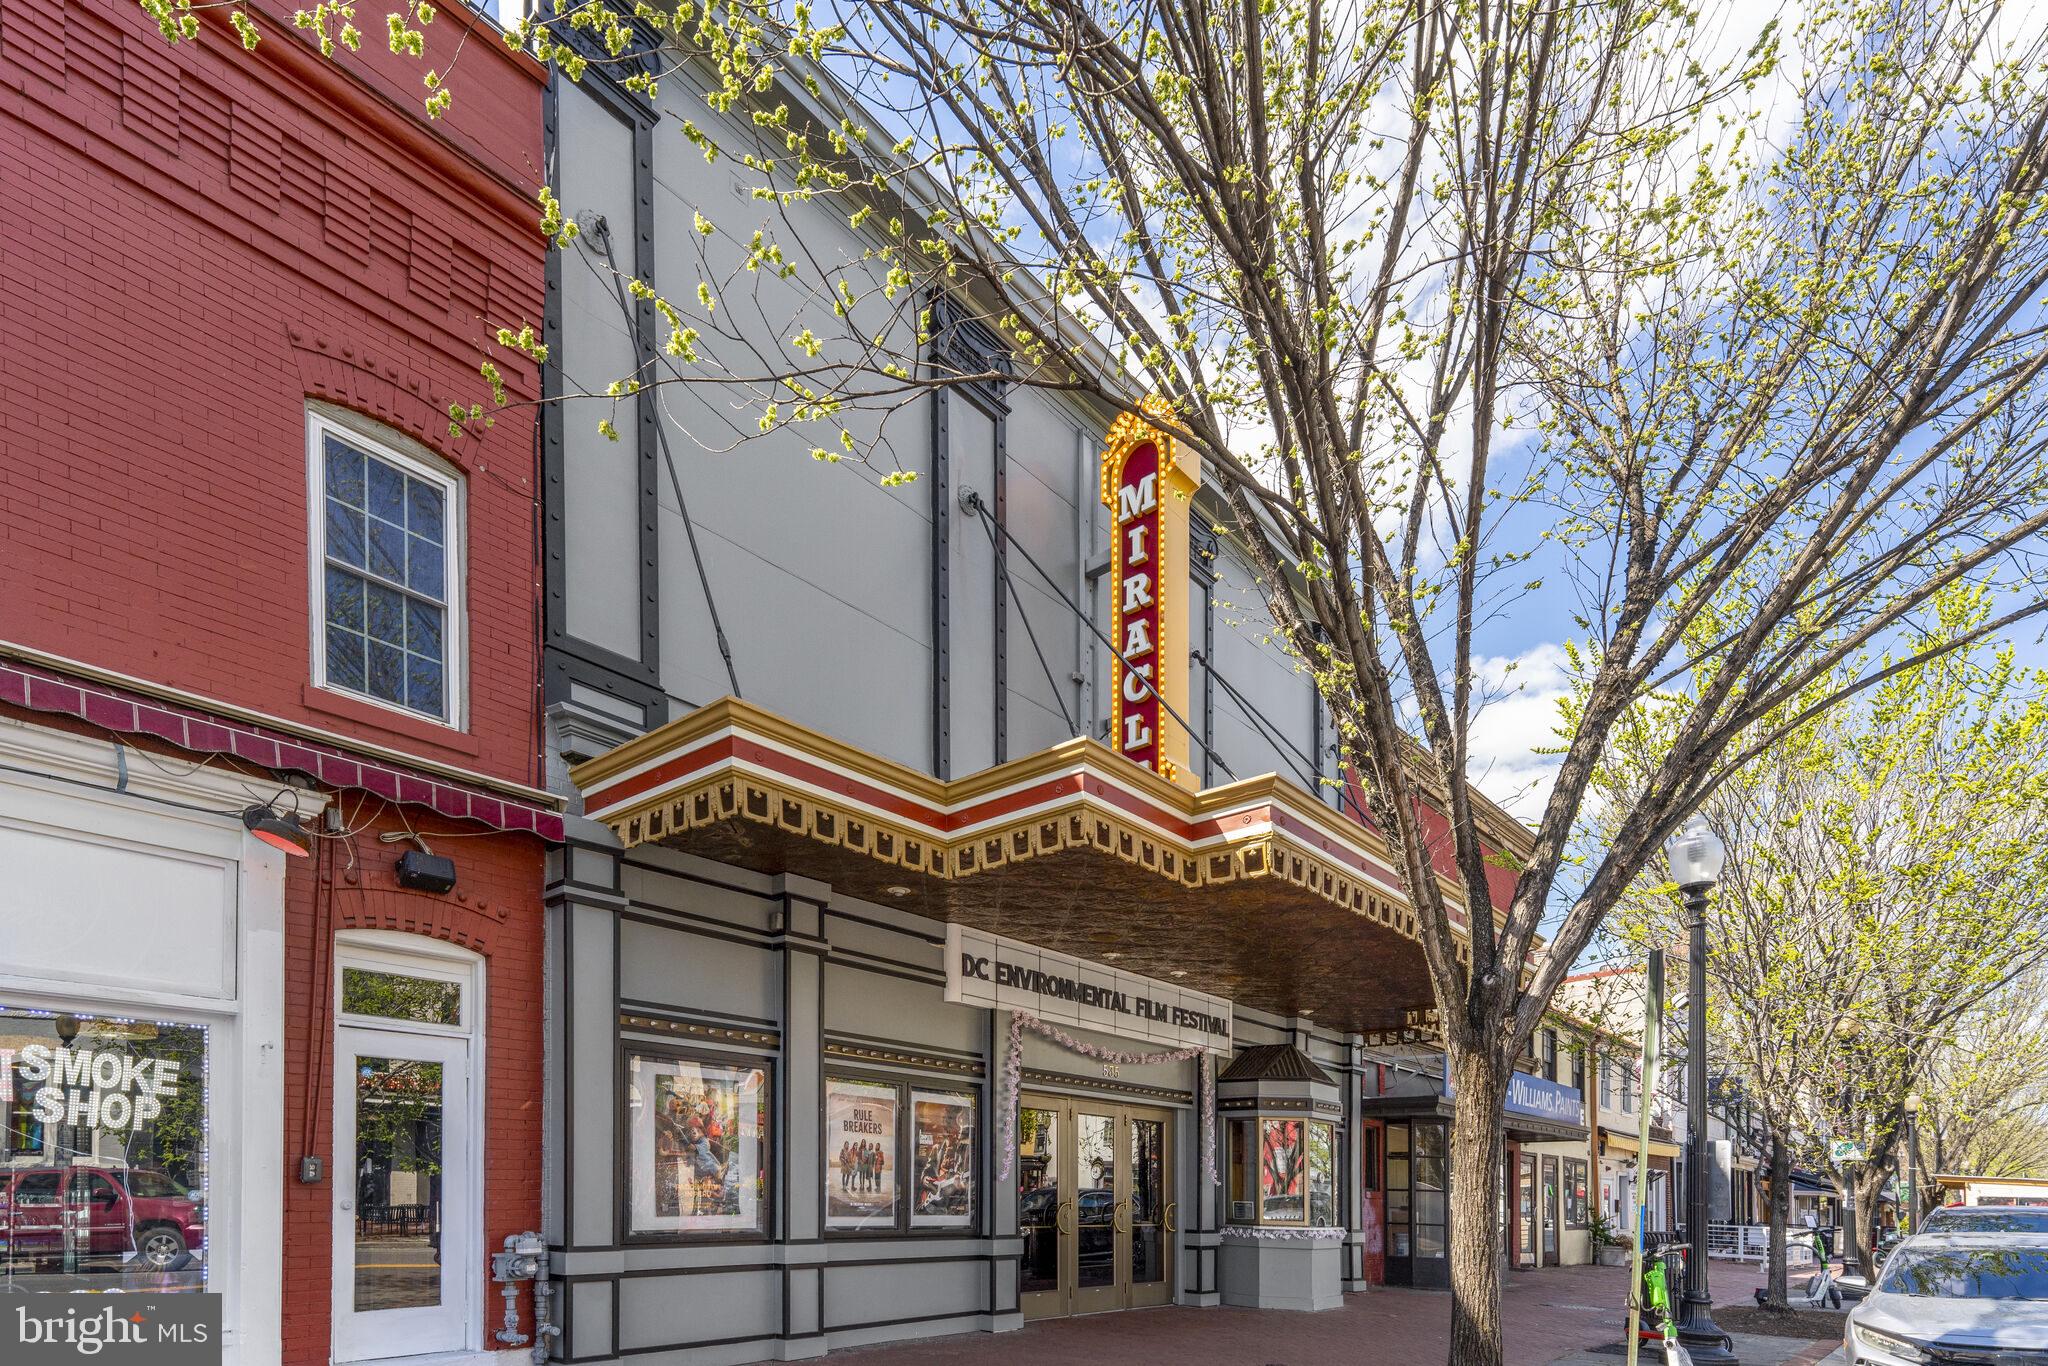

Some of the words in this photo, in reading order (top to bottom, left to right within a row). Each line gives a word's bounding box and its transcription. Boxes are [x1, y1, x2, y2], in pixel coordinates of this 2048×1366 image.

[1118, 472, 1158, 770] MIRACL
[962, 953, 989, 981] DC
[996, 961, 1131, 1014] ENVIRONMENTAL
[1136, 997, 1168, 1023] FILM
[1173, 1006, 1230, 1037] FESTIVAL
[19, 1044, 181, 1096] SMOKE
[32, 1087, 161, 1131] SHOP
[843, 1120, 882, 1135] BREAKERS
[853, 1109, 873, 1121] RULE
